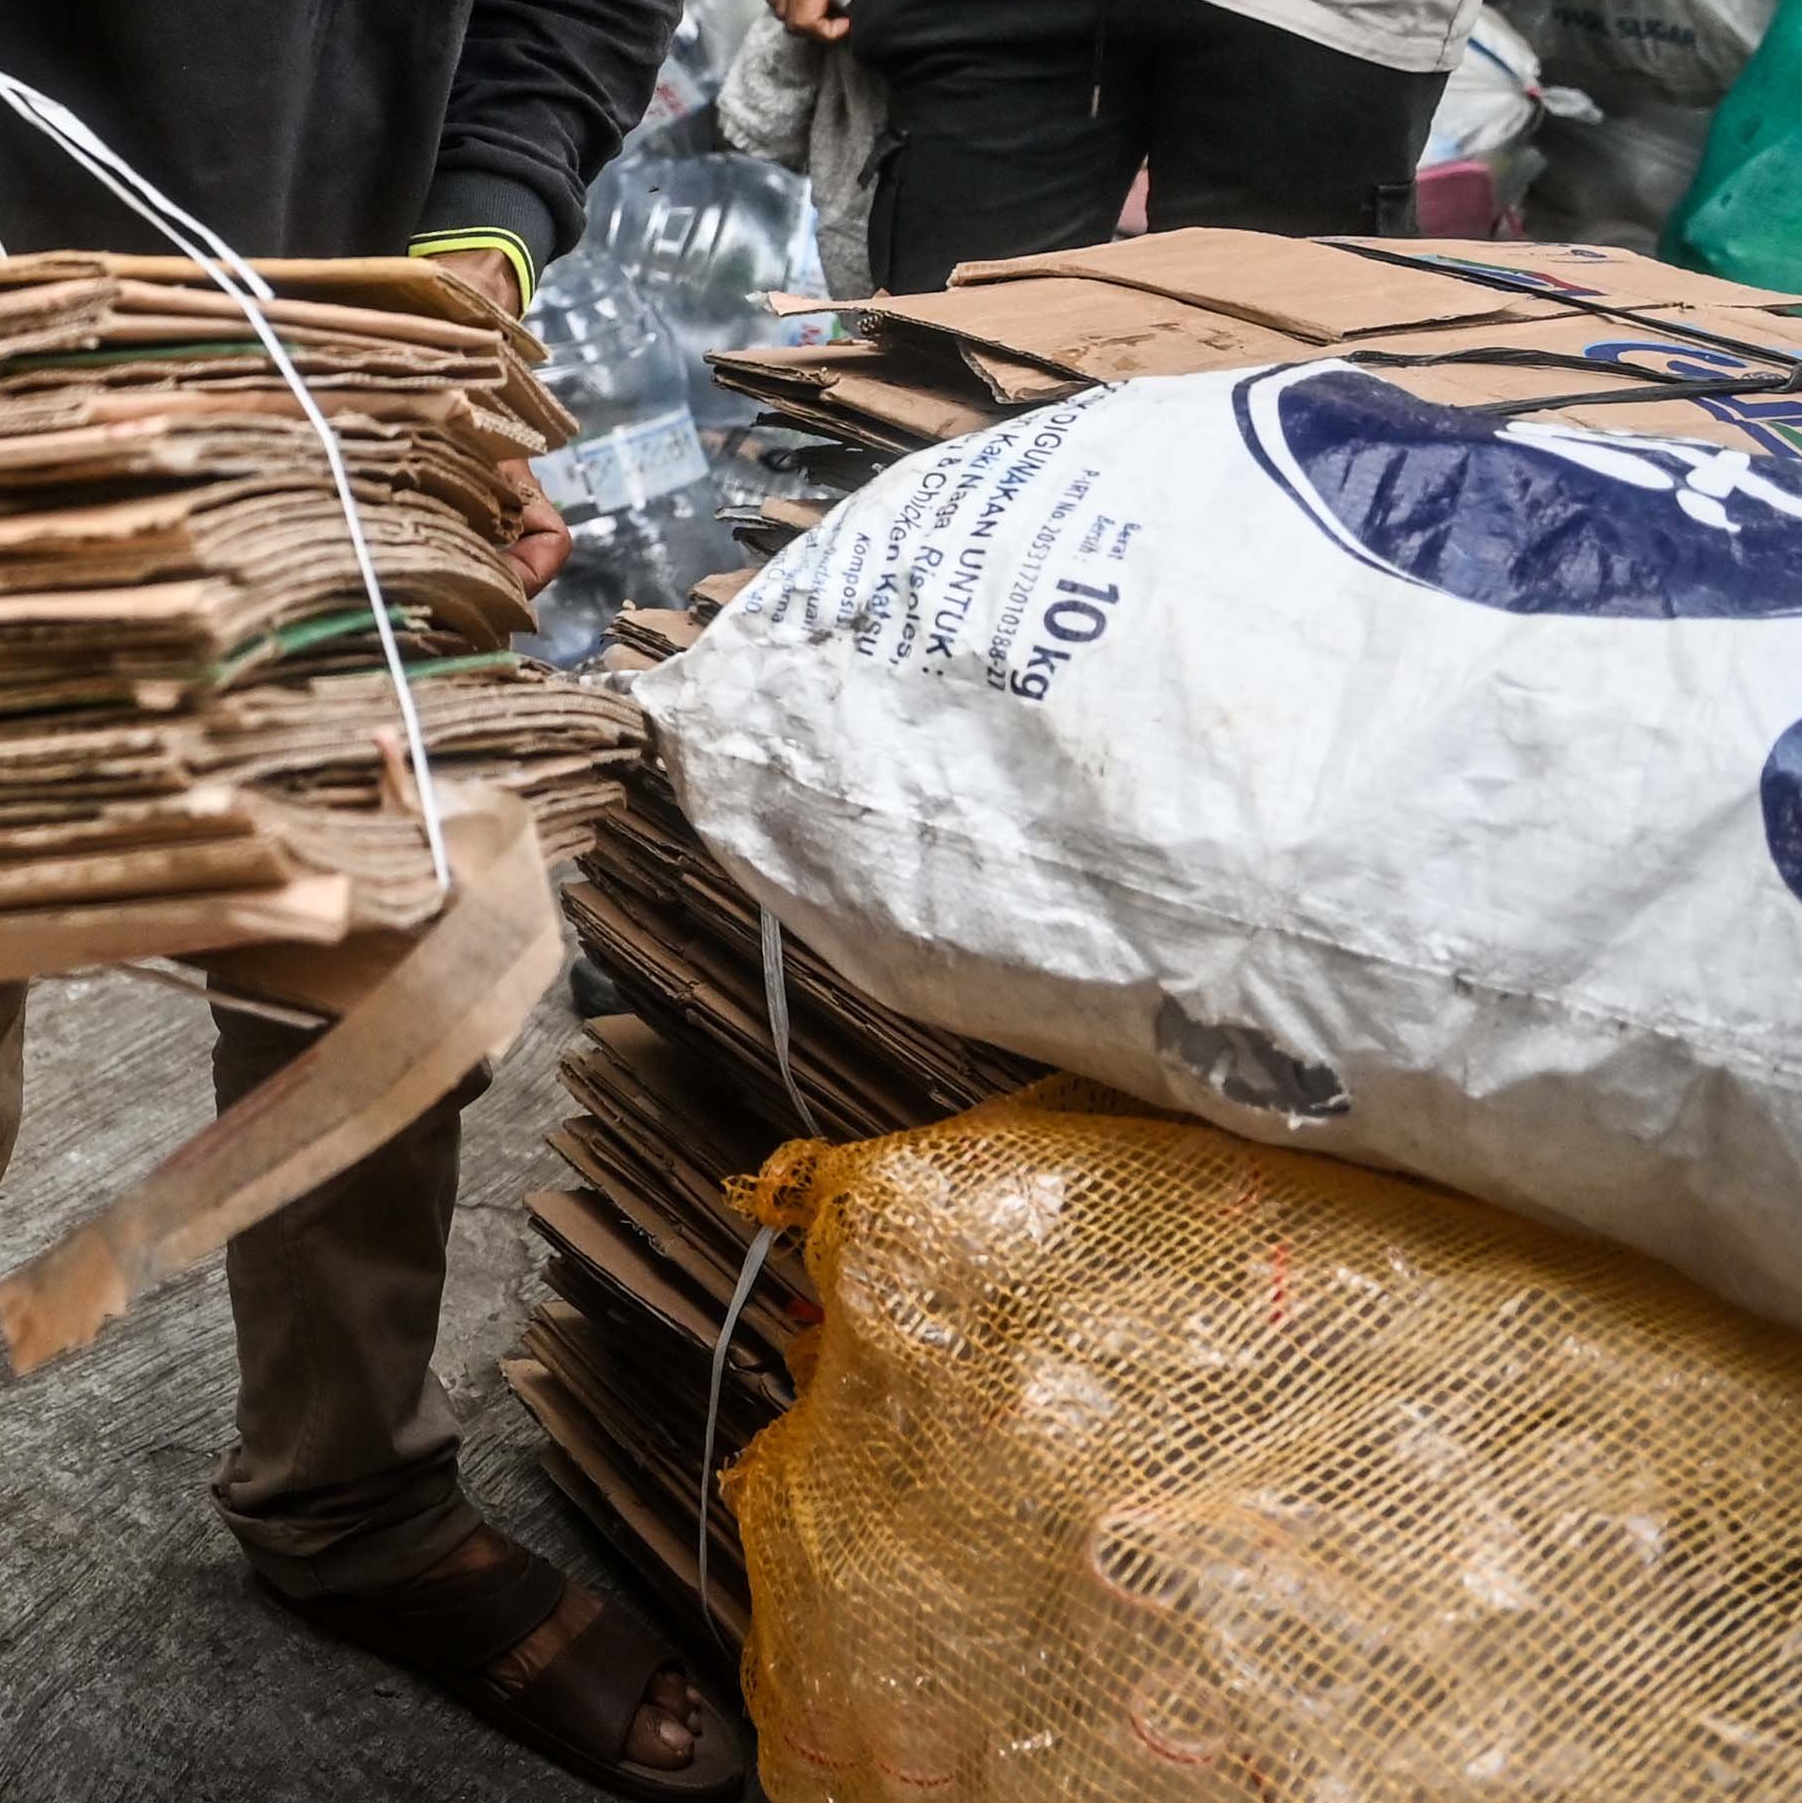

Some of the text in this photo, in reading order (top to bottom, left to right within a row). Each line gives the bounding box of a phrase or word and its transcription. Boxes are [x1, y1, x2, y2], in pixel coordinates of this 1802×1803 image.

[969, 412, 1078, 538] DIGUNAKAN
[970, 433, 1019, 469] Kaki
[886, 471, 947, 562] Chicken
[1106, 522, 1142, 561] Berat
[854, 572, 901, 658] Katsu
[925, 547, 987, 660] UNTUK
[1009, 578, 1120, 702] 10 kg
